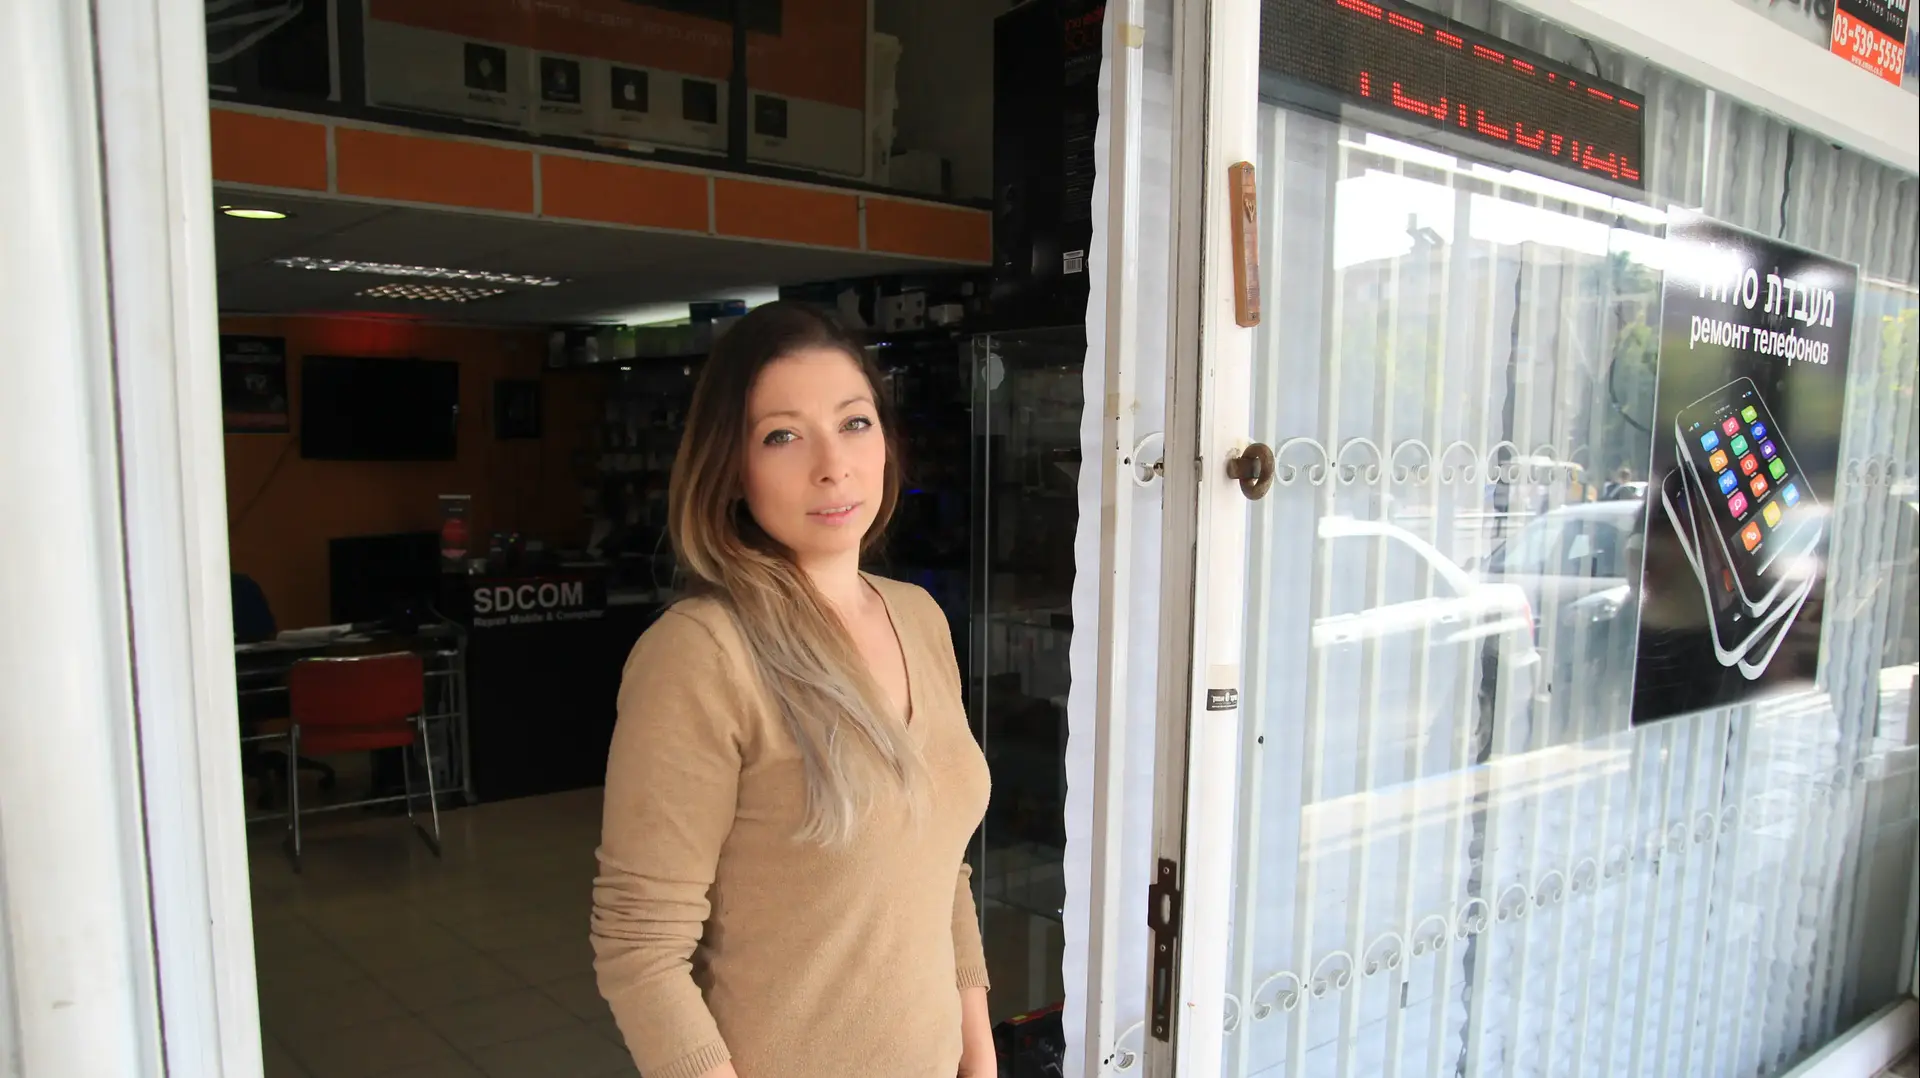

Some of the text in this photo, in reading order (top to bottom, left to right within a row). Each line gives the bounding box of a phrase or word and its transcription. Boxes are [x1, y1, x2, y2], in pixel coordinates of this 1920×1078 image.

[1834, 13, 1904, 75] 03-539-5555
[1764, 274, 1835, 328] מעבדת
[1689, 315, 1829, 367] ремонт телефонов
[474, 582, 583, 613] SDCOM
